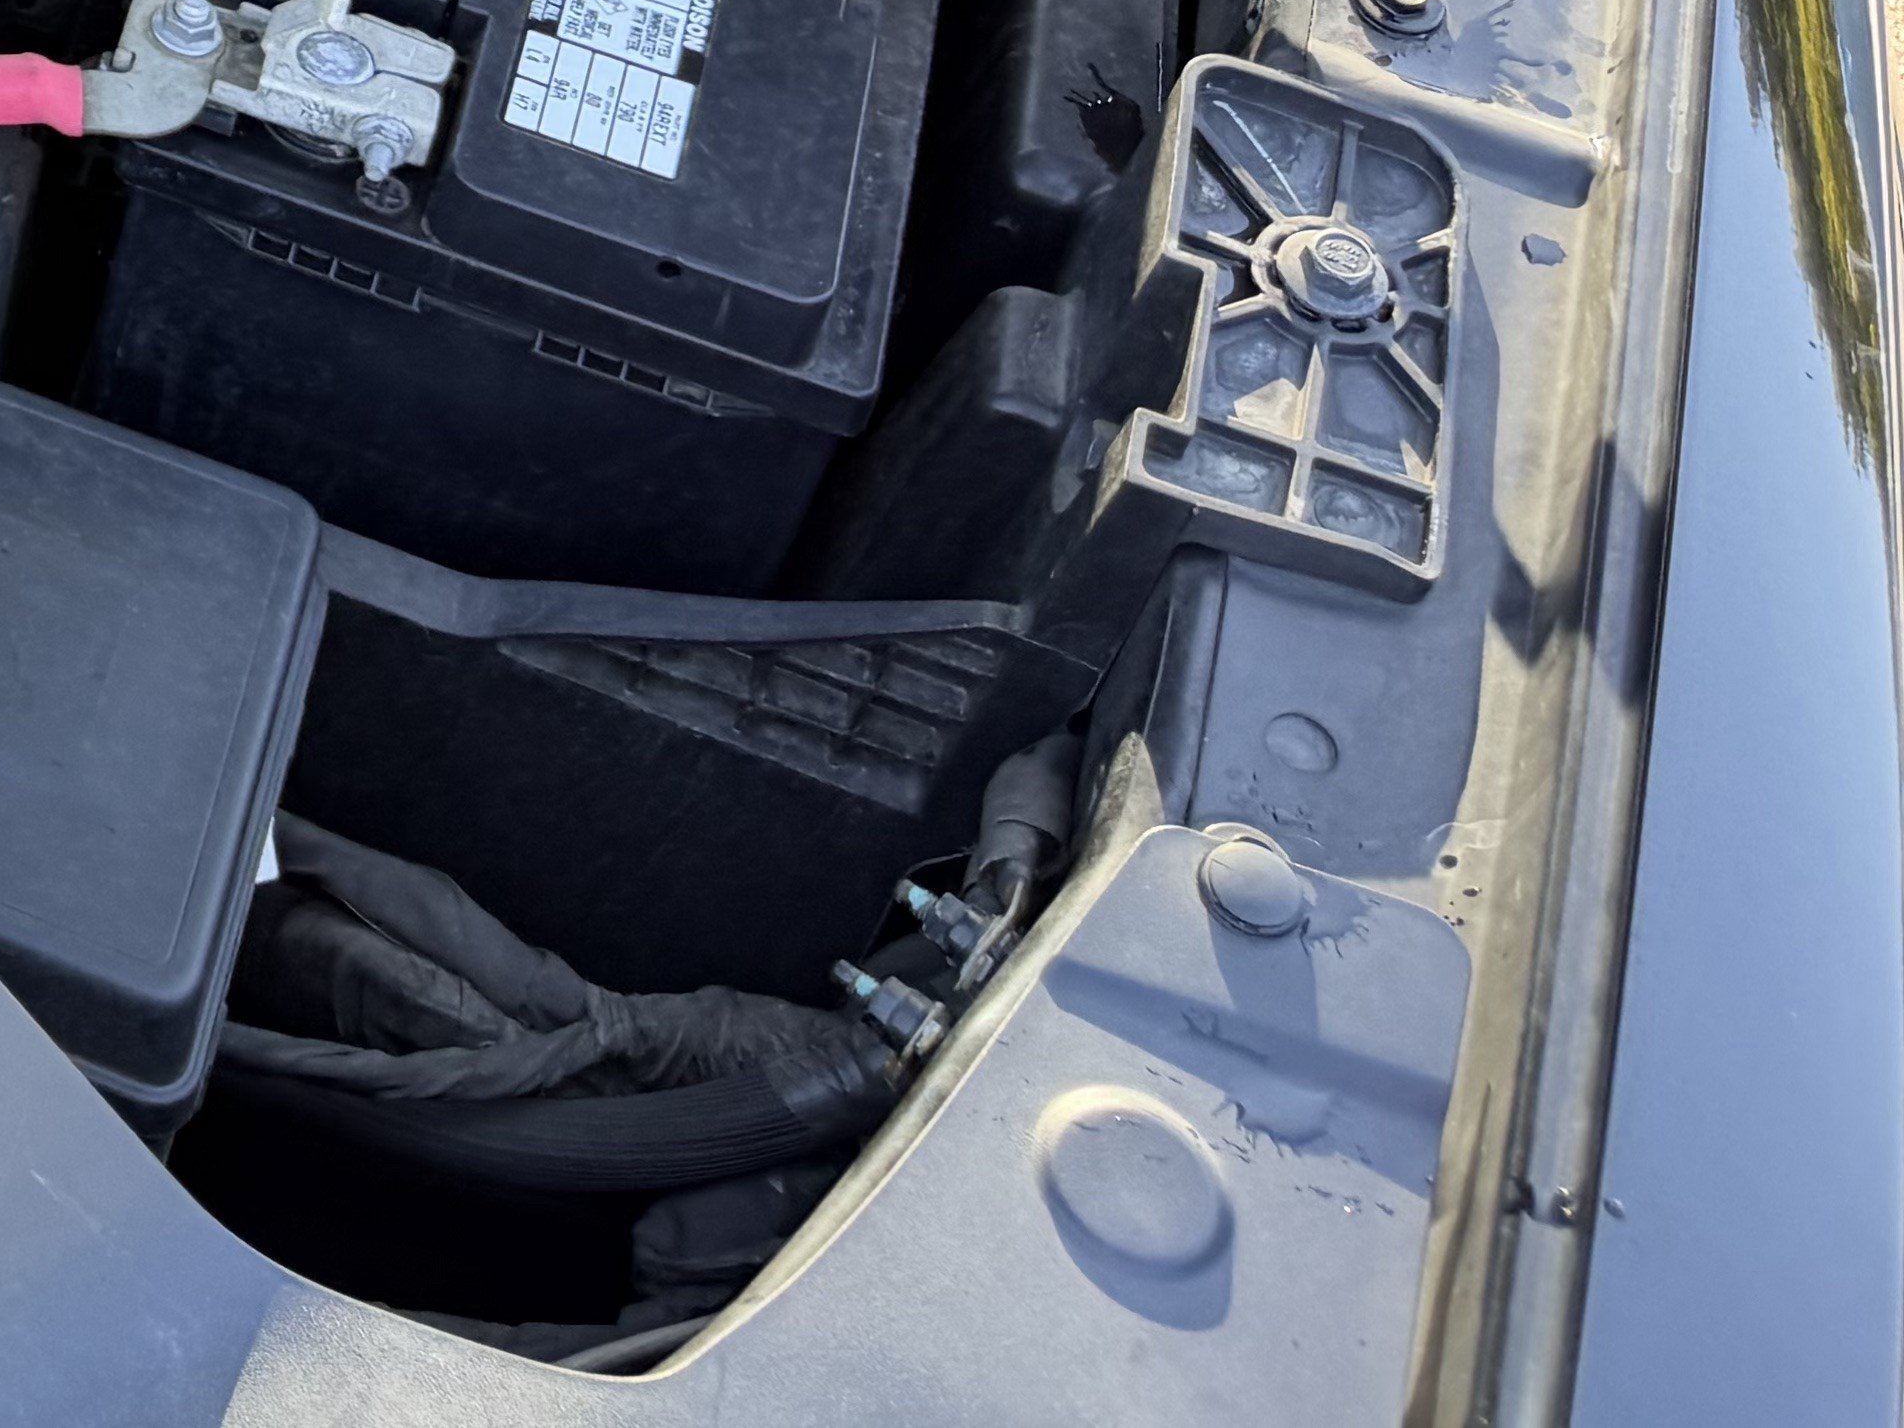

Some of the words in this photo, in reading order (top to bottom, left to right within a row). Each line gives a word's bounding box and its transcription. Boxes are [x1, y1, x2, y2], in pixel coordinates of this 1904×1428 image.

[549, 77, 570, 101] 94R
[511, 92, 530, 110] H7
[617, 100, 637, 123] 790
[648, 100, 674, 146] 94REXT
